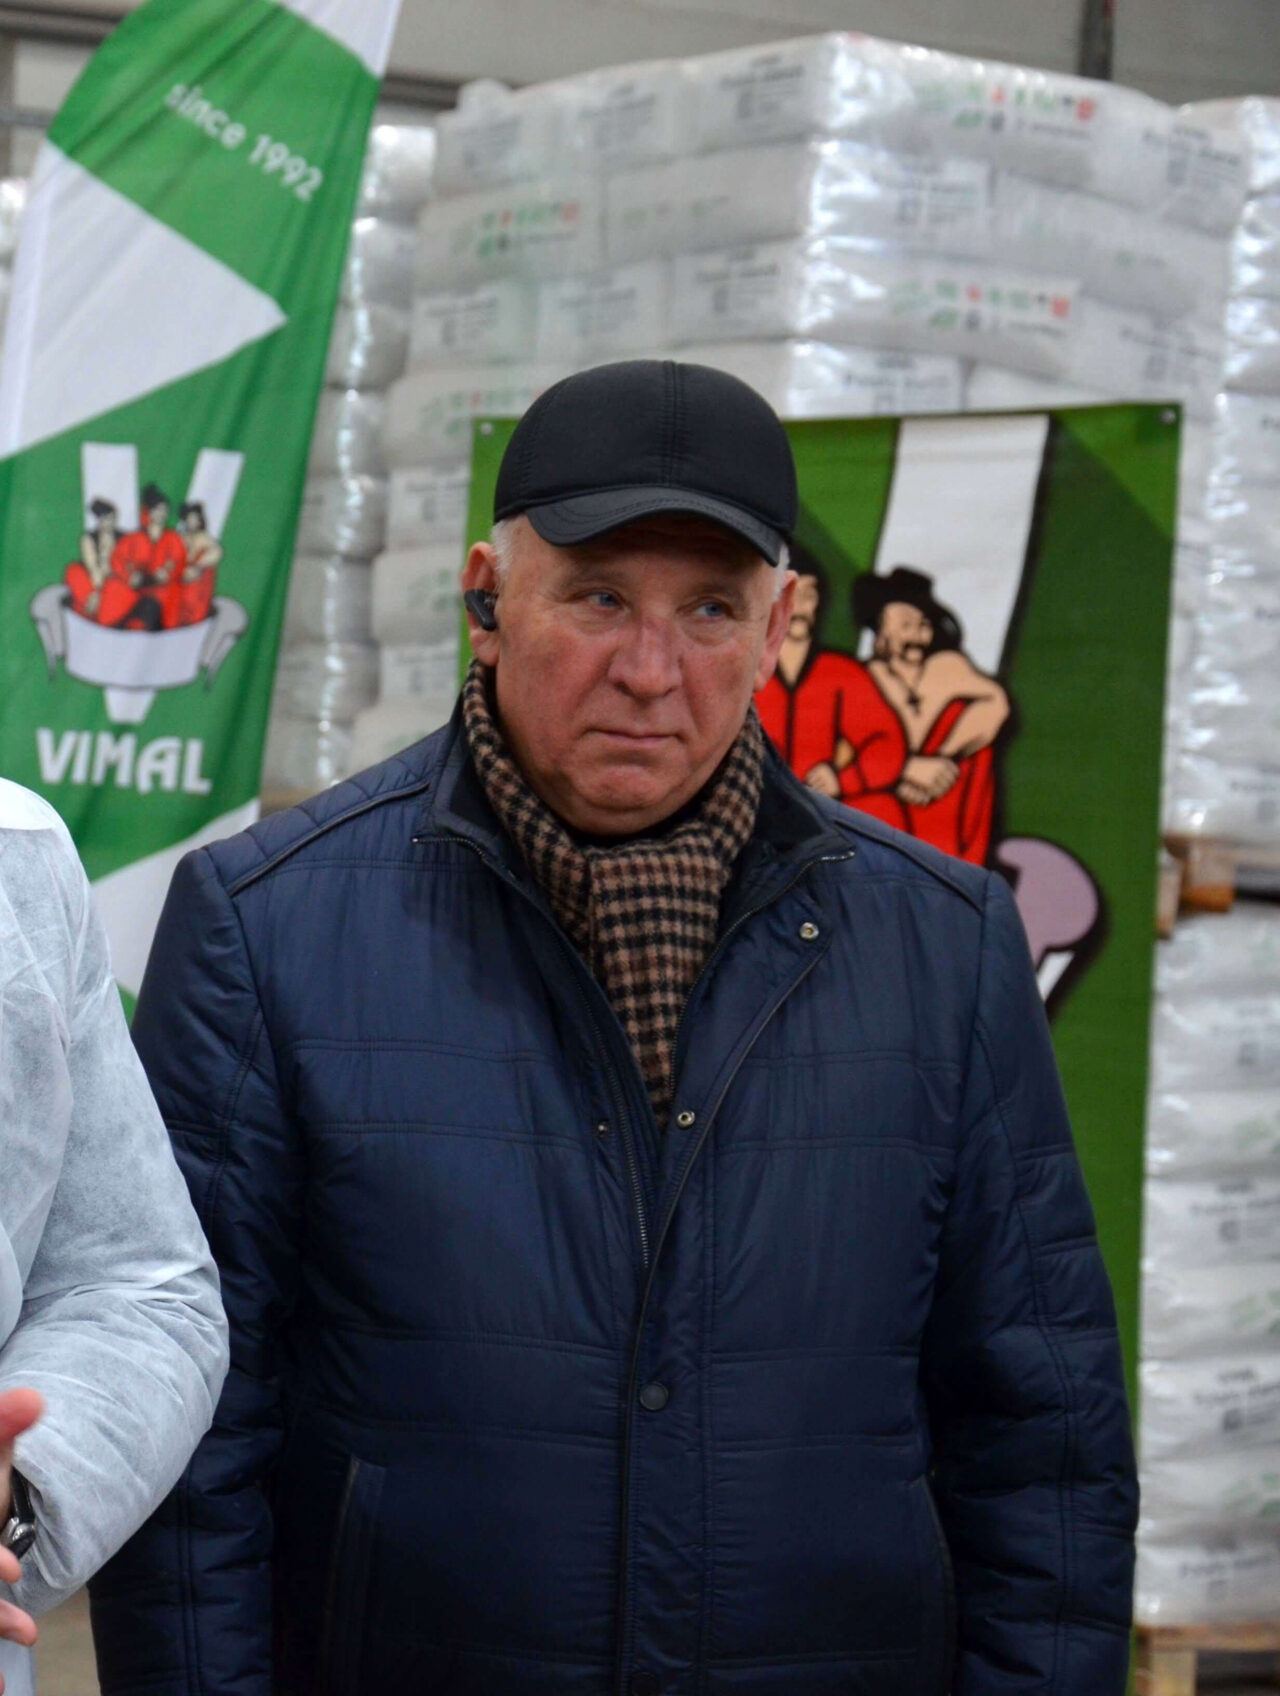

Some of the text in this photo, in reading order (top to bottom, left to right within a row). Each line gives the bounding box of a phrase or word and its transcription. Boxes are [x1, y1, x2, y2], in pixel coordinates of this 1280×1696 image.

[165, 84, 323, 201] since 1992
[36, 727, 213, 796] VIMAL
